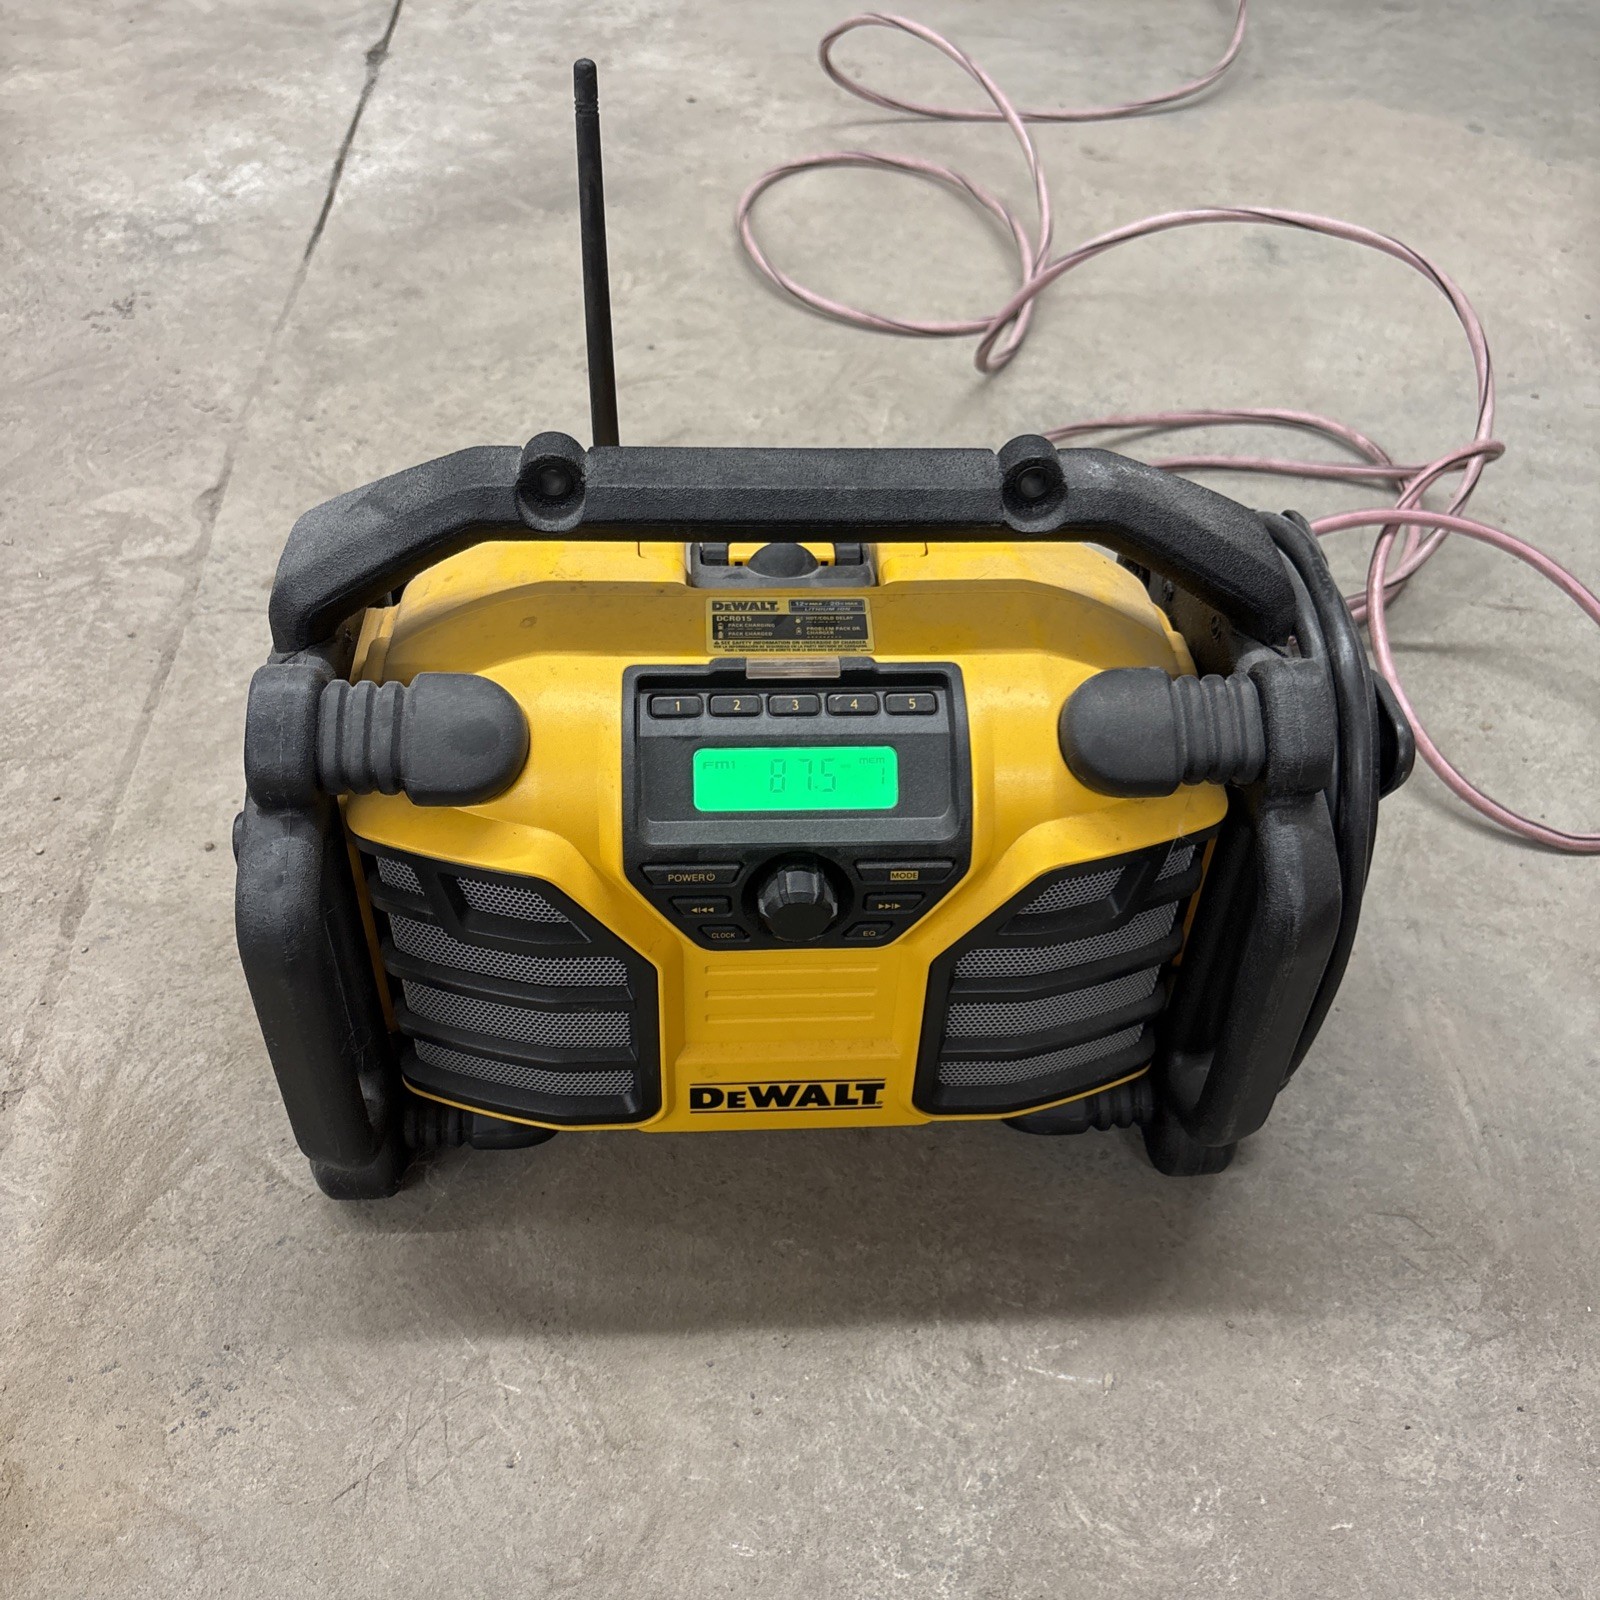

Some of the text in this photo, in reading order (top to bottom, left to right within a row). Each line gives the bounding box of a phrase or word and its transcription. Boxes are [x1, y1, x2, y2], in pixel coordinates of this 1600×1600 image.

[675, 701, 680, 712] 1
[733, 700, 741, 711] 2
[792, 700, 799, 711] 3
[850, 700, 858, 711] 4
[909, 699, 916, 710] 5
[703, 761, 735, 769] FM1
[769, 758, 837, 793] 87.5
[668, 873, 705, 882] POWER
[891, 872, 917, 880] MODE
[711, 931, 736, 939] CLOCK
[863, 929, 876, 938] EQ
[690, 1083, 886, 1109] DEWALT
